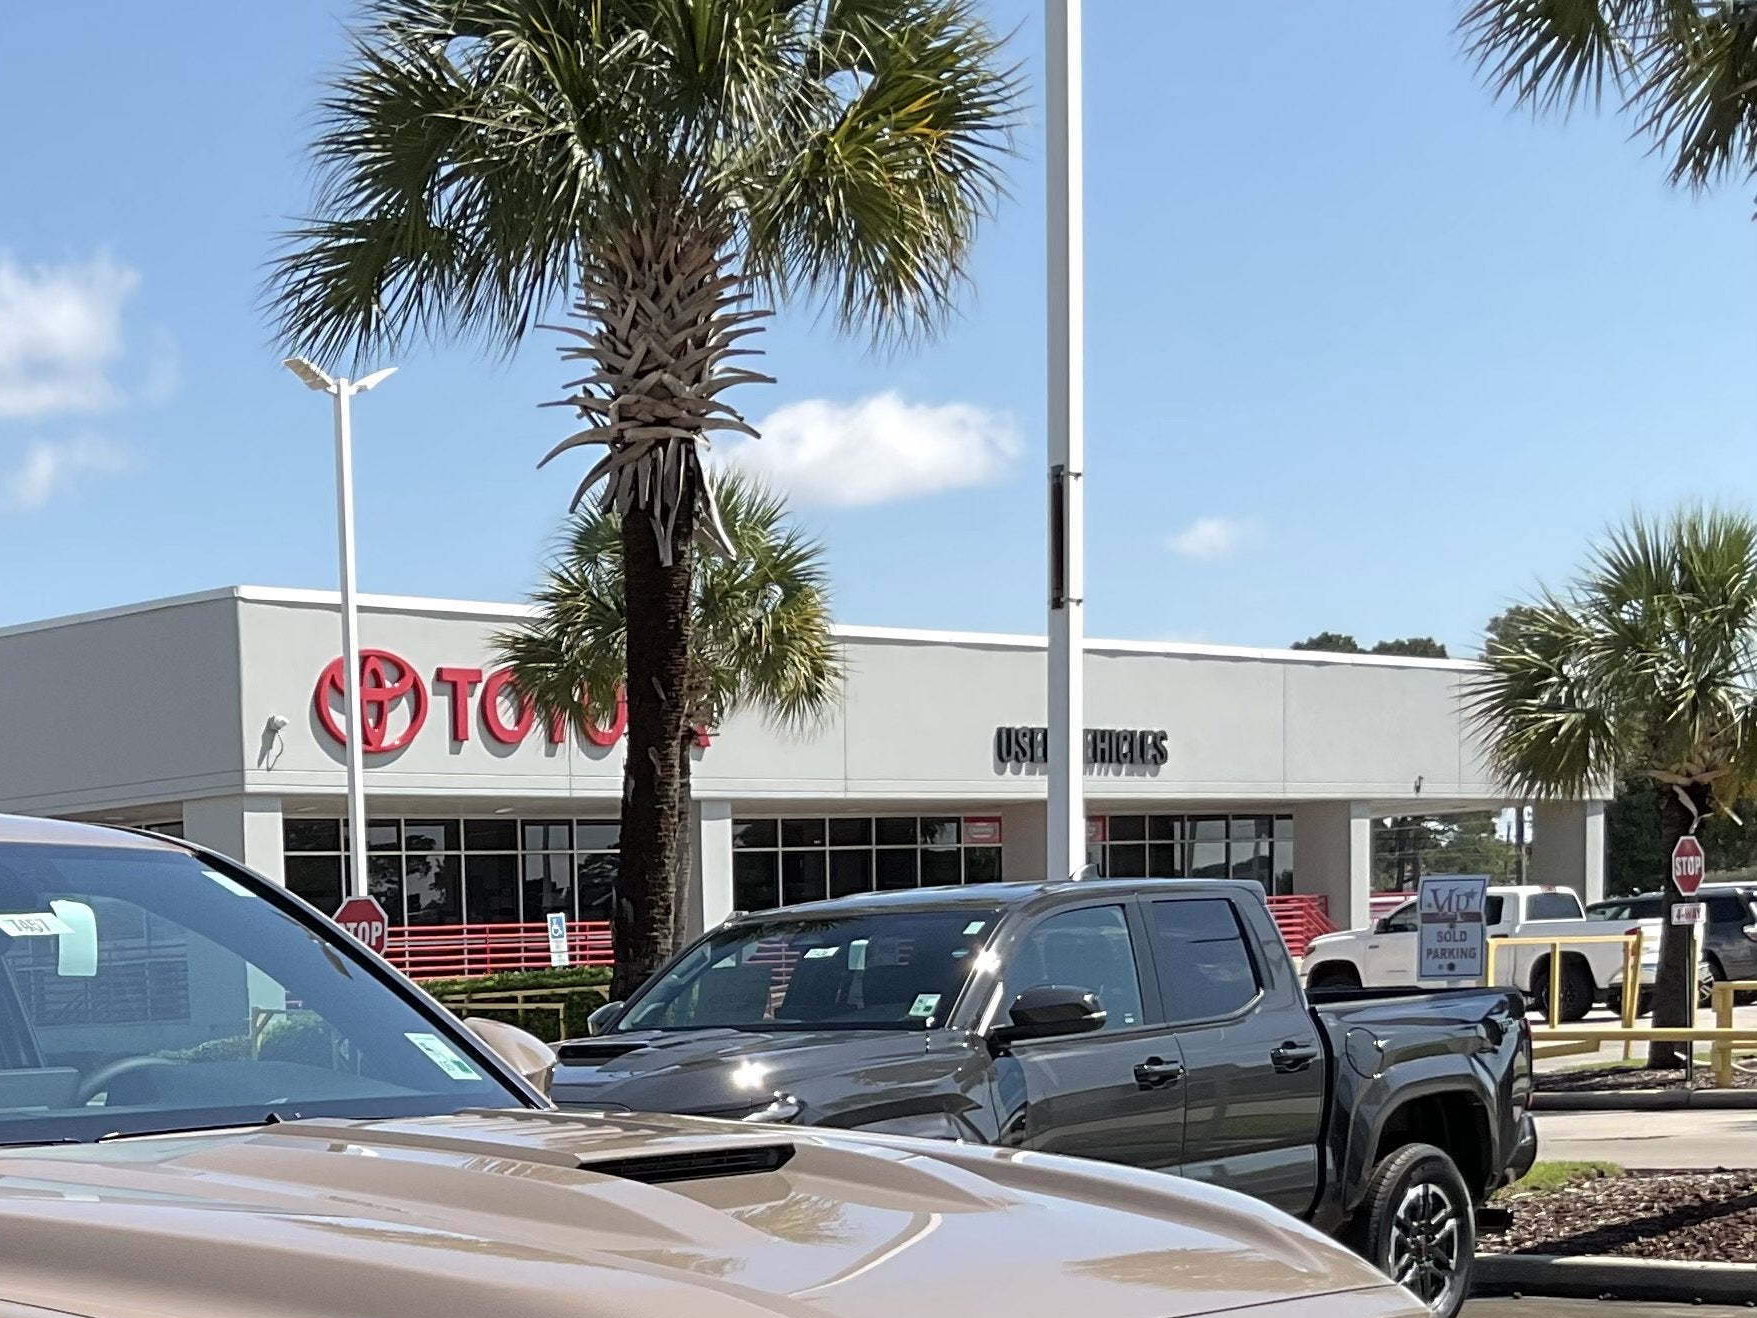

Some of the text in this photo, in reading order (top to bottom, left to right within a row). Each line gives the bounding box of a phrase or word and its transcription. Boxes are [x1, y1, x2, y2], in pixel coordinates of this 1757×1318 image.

[996, 727, 1168, 766] USE EHICLES
[1675, 856, 1701, 877] STOP
[1675, 907, 1702, 921] 4-WAY
[1436, 930, 1468, 943] SOLD
[1426, 947, 1477, 961] PARKING
